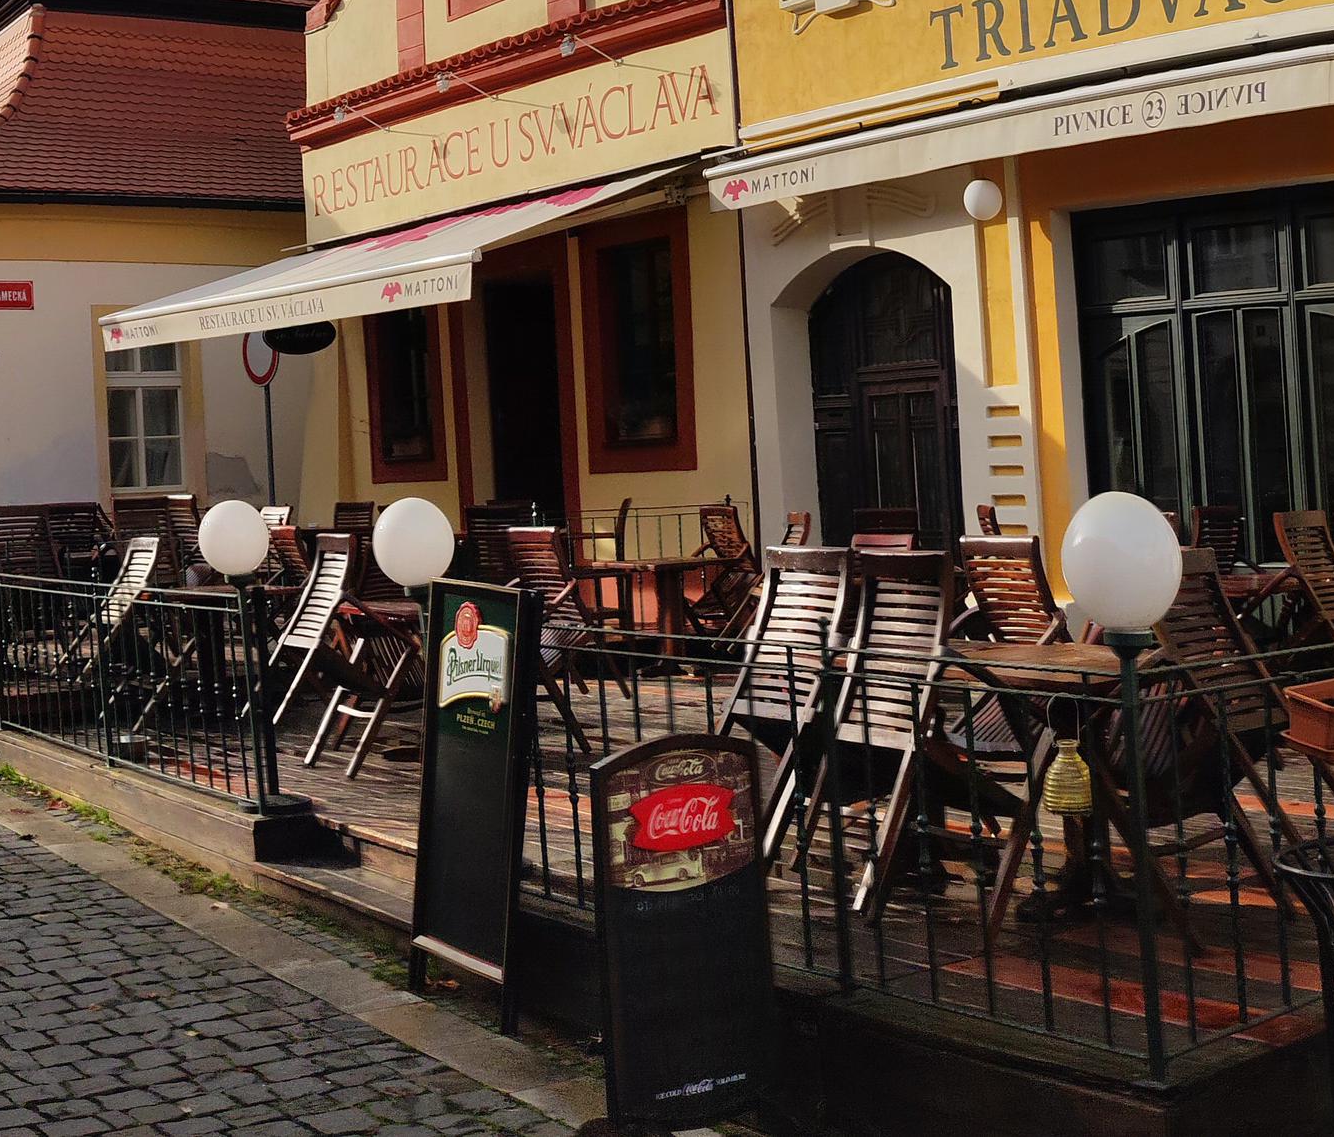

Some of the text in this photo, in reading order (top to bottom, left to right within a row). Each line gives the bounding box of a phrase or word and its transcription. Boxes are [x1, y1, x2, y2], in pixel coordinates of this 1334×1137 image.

[1052, 103, 1134, 137] PIVNICE
[1145, 98, 1164, 122] 23
[313, 125, 484, 218] RESTAURACE
[488, 117, 512, 169] U
[559, 63, 720, 150] VÁCLAVA
[751, 166, 815, 195] MATTONI
[404, 274, 459, 298] MATTONI
[198, 308, 257, 331] RESTAURACE
[280, 296, 326, 318] VÁCLAVA
[124, 325, 160, 341] MATTONI
[447, 646, 477, 686] Pilsner
